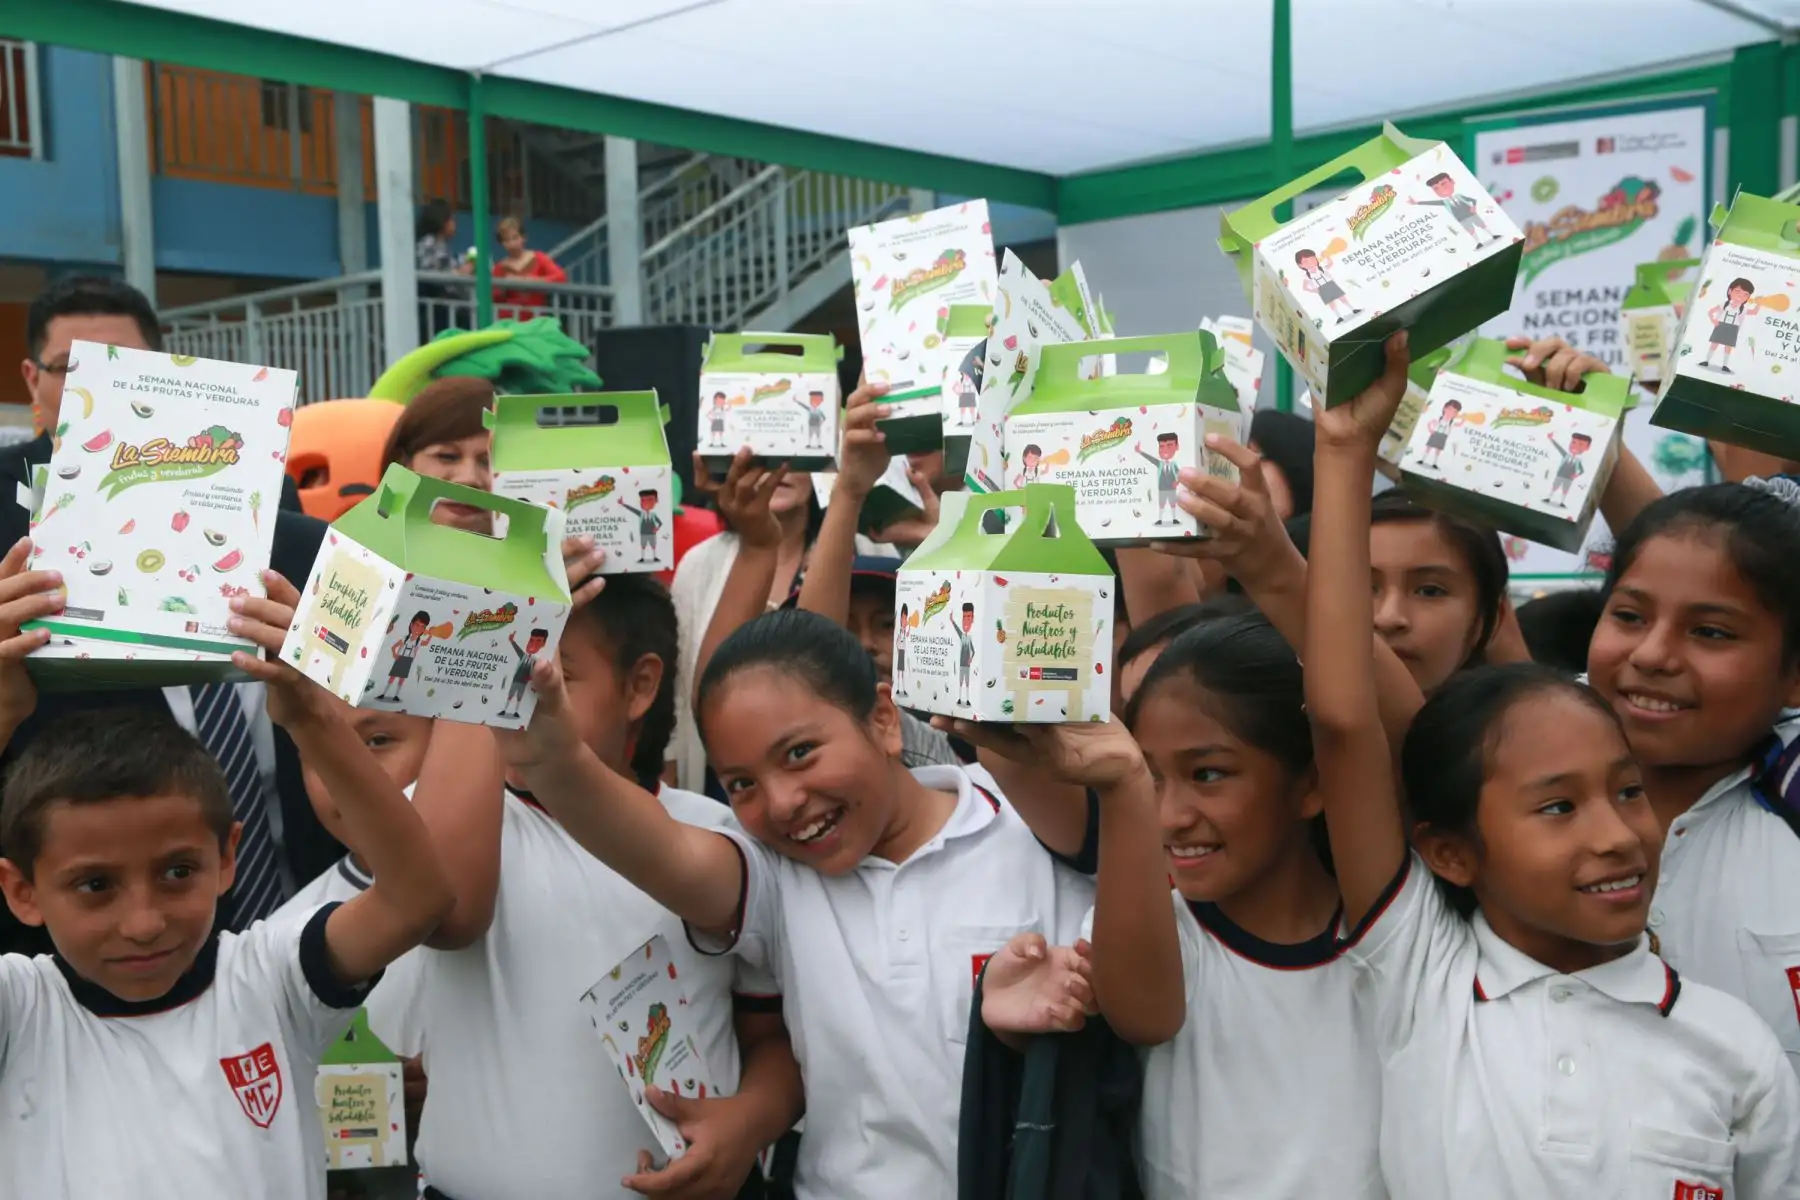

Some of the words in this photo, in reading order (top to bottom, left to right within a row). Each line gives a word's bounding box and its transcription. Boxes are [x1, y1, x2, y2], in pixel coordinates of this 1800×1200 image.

[1342, 240, 1384, 265] SEMANA
[1385, 212, 1438, 241] NACIONAL
[1357, 255, 1373, 266] DE
[1373, 245, 1394, 258] LAS
[1394, 223, 1434, 247] FRUTAS
[1379, 233, 1433, 265] VERDURAS
[1523, 308, 1619, 330] NACION
[1764, 316, 1799, 332] SEMA
[1775, 330, 1793, 340] DE
[1782, 342, 1789, 351] Y
[113, 380, 127, 389] DE
[130, 382, 150, 392] LAS
[153, 386, 192, 398] FRUTAS
[205, 393, 260, 407] VERDURAS
[138, 375, 181, 387] SEMANA
[185, 380, 238, 395] NACIONAL
[110, 441, 141, 471] La
[140, 437, 240, 467] Siembra
[1503, 439, 1549, 458] NACIONAL
[1481, 448, 1528, 469] VERDURAS
[118, 469, 149, 484] frutas
[160, 465, 204, 477] verduras
[1055, 470, 1096, 479] SEMANA
[1099, 467, 1148, 477] NACIONAL
[1066, 480, 1078, 488] DE
[1081, 480, 1100, 488] LAS
[1102, 477, 1139, 487] FRUTAS
[1081, 488, 1133, 497] VERDURAS
[582, 516, 627, 524] NACIONAL
[1026, 602, 1075, 623] Productos
[929, 636, 954, 646] NACIONAL
[1022, 620, 1065, 639] Nuestros
[1069, 626, 1077, 644] y
[429, 644, 464, 656] SEMANA
[466, 650, 509, 664] NACIONAL
[921, 646, 929, 654] LAS
[930, 646, 948, 656] FRUTAS
[1016, 639, 1076, 659] Saludables
[434, 656, 447, 665] DE
[448, 658, 464, 667] LAS
[466, 660, 497, 671] FRUTAS
[445, 668, 488, 680] VERDURAS
